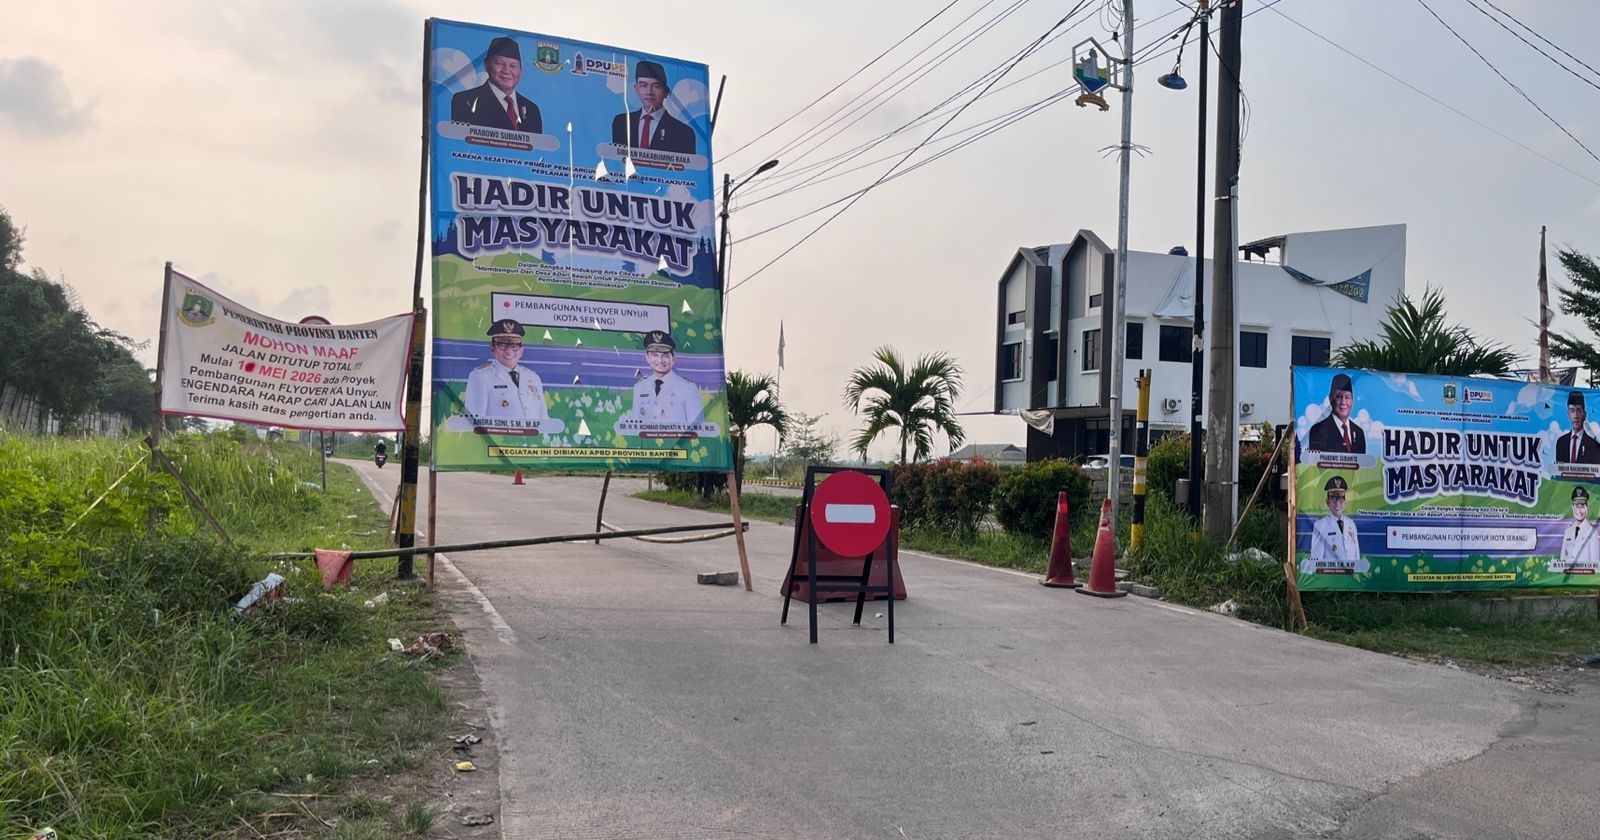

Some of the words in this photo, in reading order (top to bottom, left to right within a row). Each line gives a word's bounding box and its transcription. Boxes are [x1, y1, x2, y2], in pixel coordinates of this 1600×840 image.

[470, 128, 499, 138] PRABOWO
[500, 132, 530, 142] SUBIANTO
[452, 152, 482, 161] KARENA
[617, 148, 638, 157] GIBAN
[456, 175, 570, 212] HADIR
[579, 189, 696, 230] UNTUK
[462, 216, 693, 268] MASYARAKAT
[565, 266, 602, 275] Mndukung
[221, 306, 284, 334] PEMERINTAH
[286, 325, 335, 340] PROVINSI
[339, 328, 378, 340] BANTEN
[515, 301, 582, 312] PEMBANGUNAN
[584, 306, 619, 316] FLYOVER
[621, 308, 648, 318] UNYUR
[553, 314, 578, 324] (KOTA
[222, 344, 267, 362] JALAN
[269, 354, 320, 370] DITUTUP
[323, 362, 352, 370] TOTAL
[243, 332, 308, 356] MOHON
[312, 345, 358, 360] MAAF
[190, 366, 276, 390] Pembangunan
[278, 382, 328, 396] FLYOVER
[330, 386, 343, 395] KA
[346, 386, 379, 399] Unyur.
[200, 354, 232, 368] Mulai
[238, 360, 255, 372] 1
[259, 364, 287, 380] MEI
[290, 371, 320, 384] 2026
[323, 376, 340, 384] ada
[341, 374, 376, 386] Proyek
[188, 392, 226, 406] Terima
[228, 398, 258, 411] kasih
[262, 404, 286, 416] atas
[289, 408, 346, 421] pengertian
[349, 412, 376, 421] anda.
[258, 391, 301, 406] HARAP
[304, 397, 327, 406] CARI
[329, 398, 367, 409] JALAN
[370, 400, 391, 410] LAIN
[1384, 430, 1460, 457] HADIR
[1466, 434, 1542, 463] UNTUK
[1386, 464, 1538, 498] MASYARAKAT
